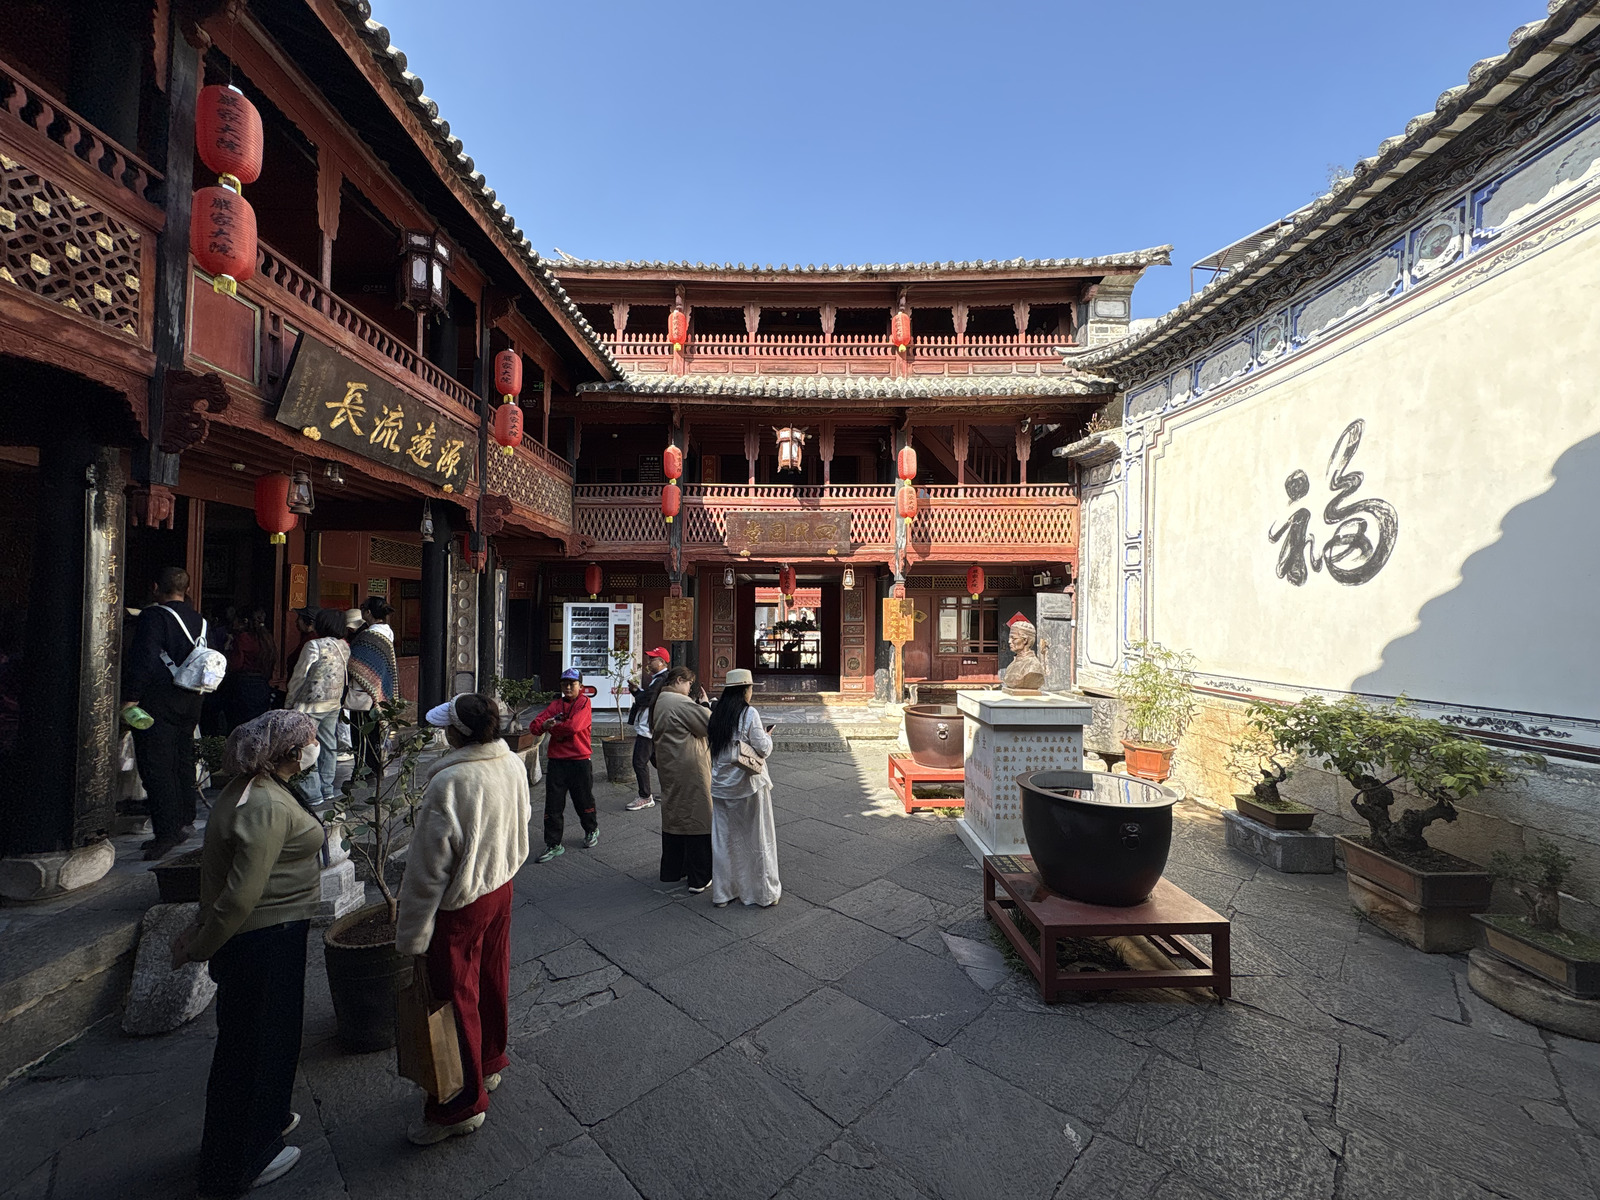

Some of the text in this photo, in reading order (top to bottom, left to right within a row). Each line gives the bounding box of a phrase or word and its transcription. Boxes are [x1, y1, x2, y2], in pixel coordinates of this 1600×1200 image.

[324, 381, 466, 480] 源遠流長
[742, 520, 838, 547] 四代同堂
[1267, 417, 1399, 588] 福
